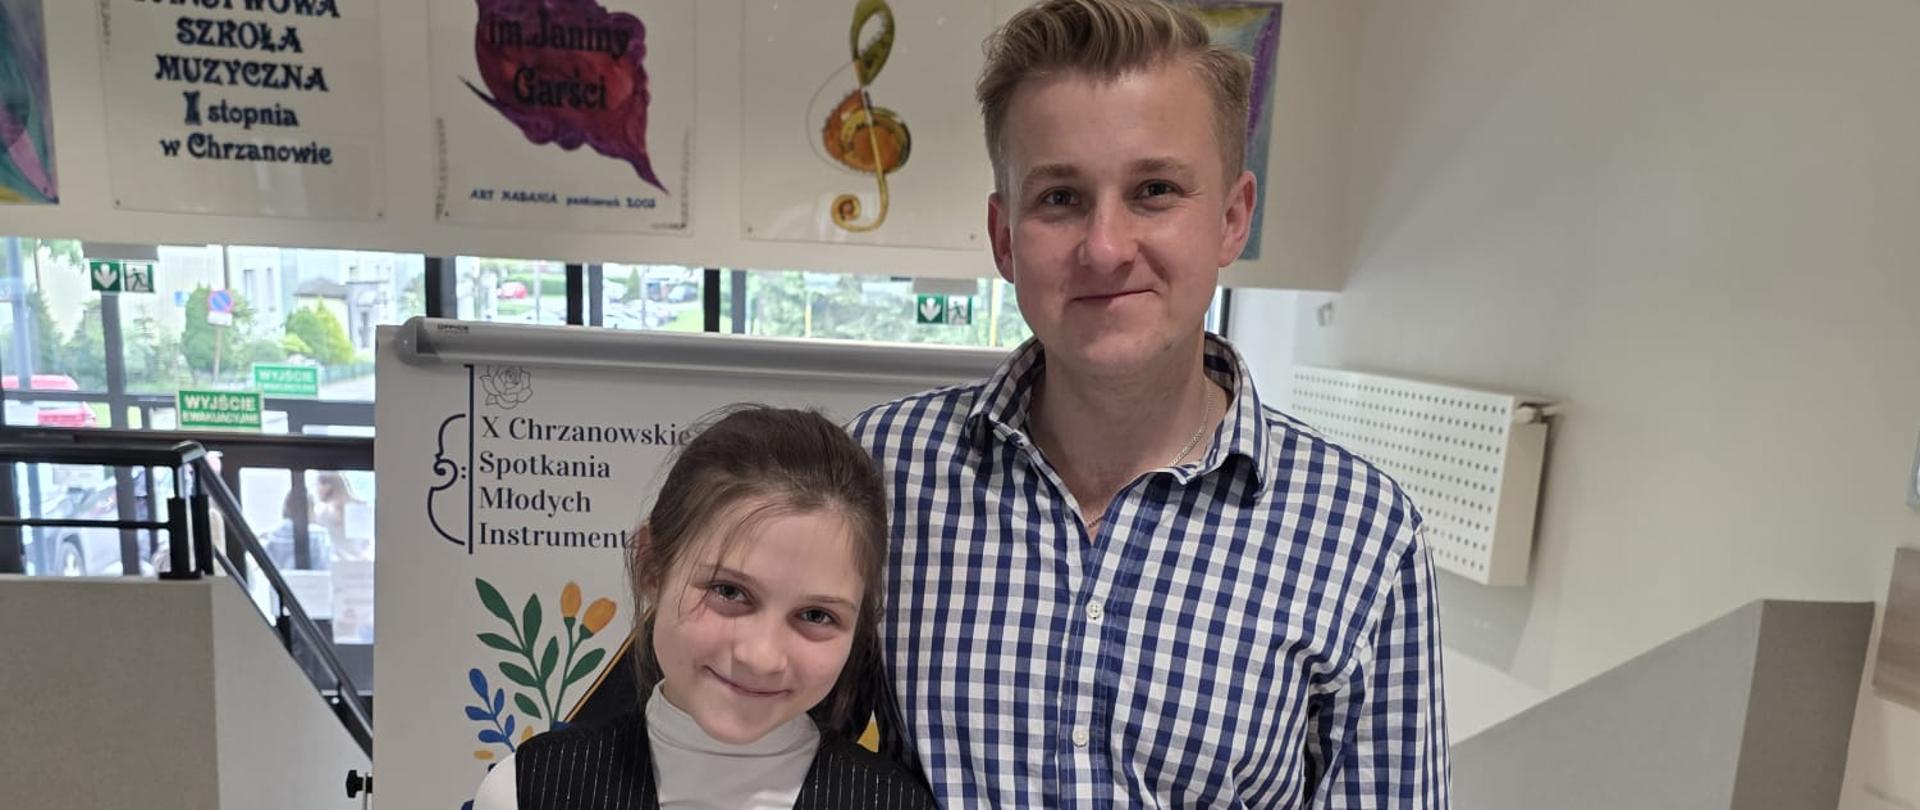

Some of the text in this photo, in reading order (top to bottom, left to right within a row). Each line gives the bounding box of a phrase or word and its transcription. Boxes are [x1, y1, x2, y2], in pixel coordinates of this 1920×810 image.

[176, 16, 303, 52] SZKOŁA
[155, 54, 329, 92] MUZYCZNA
[513, 64, 609, 110] Garści
[183, 91, 299, 130] I stopnia
[159, 133, 333, 165] w Chrzanowie
[184, 393, 257, 411] WYJŚCIE
[481, 416, 691, 447] X Chrzanowskie
[479, 451, 610, 480] Spotkania
[479, 486, 592, 518] Młodych
[479, 522, 627, 550] Instrument
